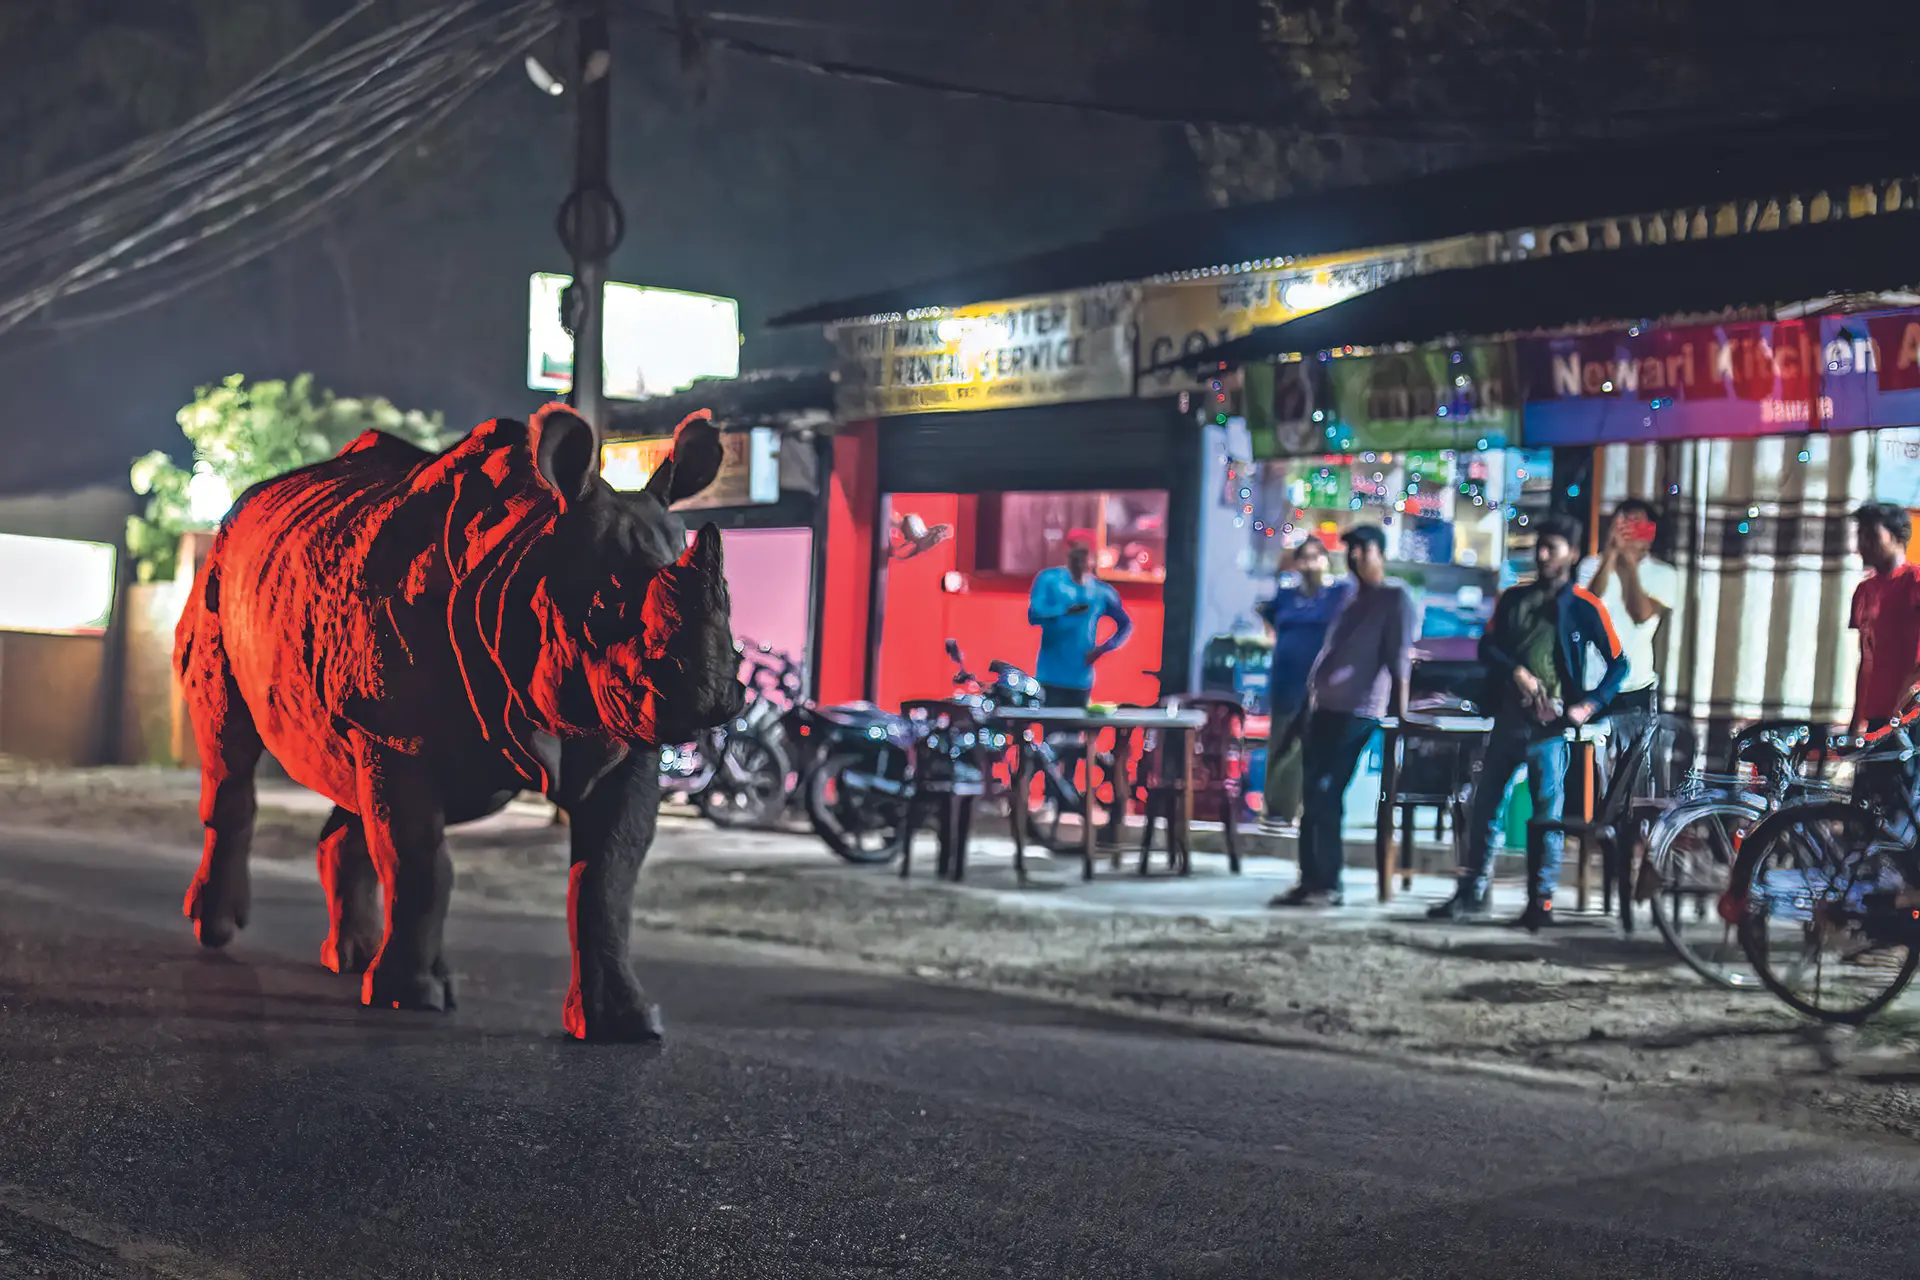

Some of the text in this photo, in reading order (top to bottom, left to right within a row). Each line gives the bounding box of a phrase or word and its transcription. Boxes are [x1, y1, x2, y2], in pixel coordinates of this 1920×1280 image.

[979, 336, 1084, 384] SERVICE
[1552, 341, 1695, 396] Newari
[1708, 331, 1881, 383] Kitchen
